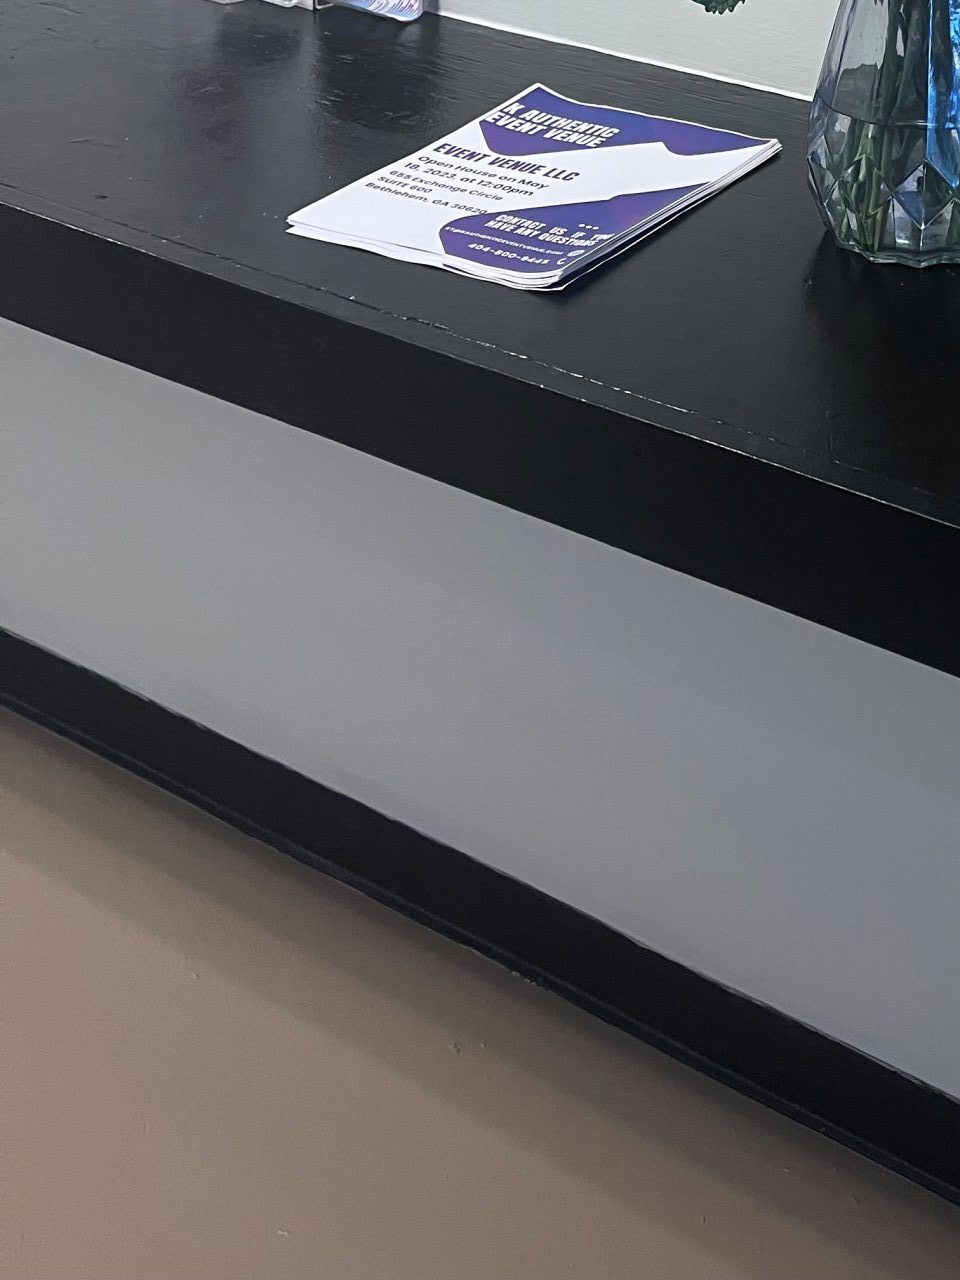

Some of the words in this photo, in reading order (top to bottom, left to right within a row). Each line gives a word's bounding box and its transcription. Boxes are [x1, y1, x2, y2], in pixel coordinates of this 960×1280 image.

[484, 111, 547, 135] EVENT
[543, 128, 607, 147] VENUE
[502, 102, 525, 115] K
[519, 109, 620, 138] AUTHENTIC
[418, 156, 452, 169] Open
[454, 164, 497, 178] House
[499, 174, 517, 183] on
[516, 178, 551, 190] May
[432, 142, 491, 163] EVENT
[488, 156, 542, 175] VENUE
[542, 167, 581, 182] LLC
[377, 176, 409, 189] SUITE
[411, 175, 468, 194] Exchange
[468, 189, 504, 201] Circle
[460, 176, 477, 185] at
[476, 179, 534, 197] 12:00pm
[432, 198, 449, 208] GA
[484, 220, 517, 234] HAVE
[513, 227, 541, 239] ANY
[495, 214, 547, 230] CONTACT
[549, 226, 568, 235] US
[570, 231, 587, 240] IF
